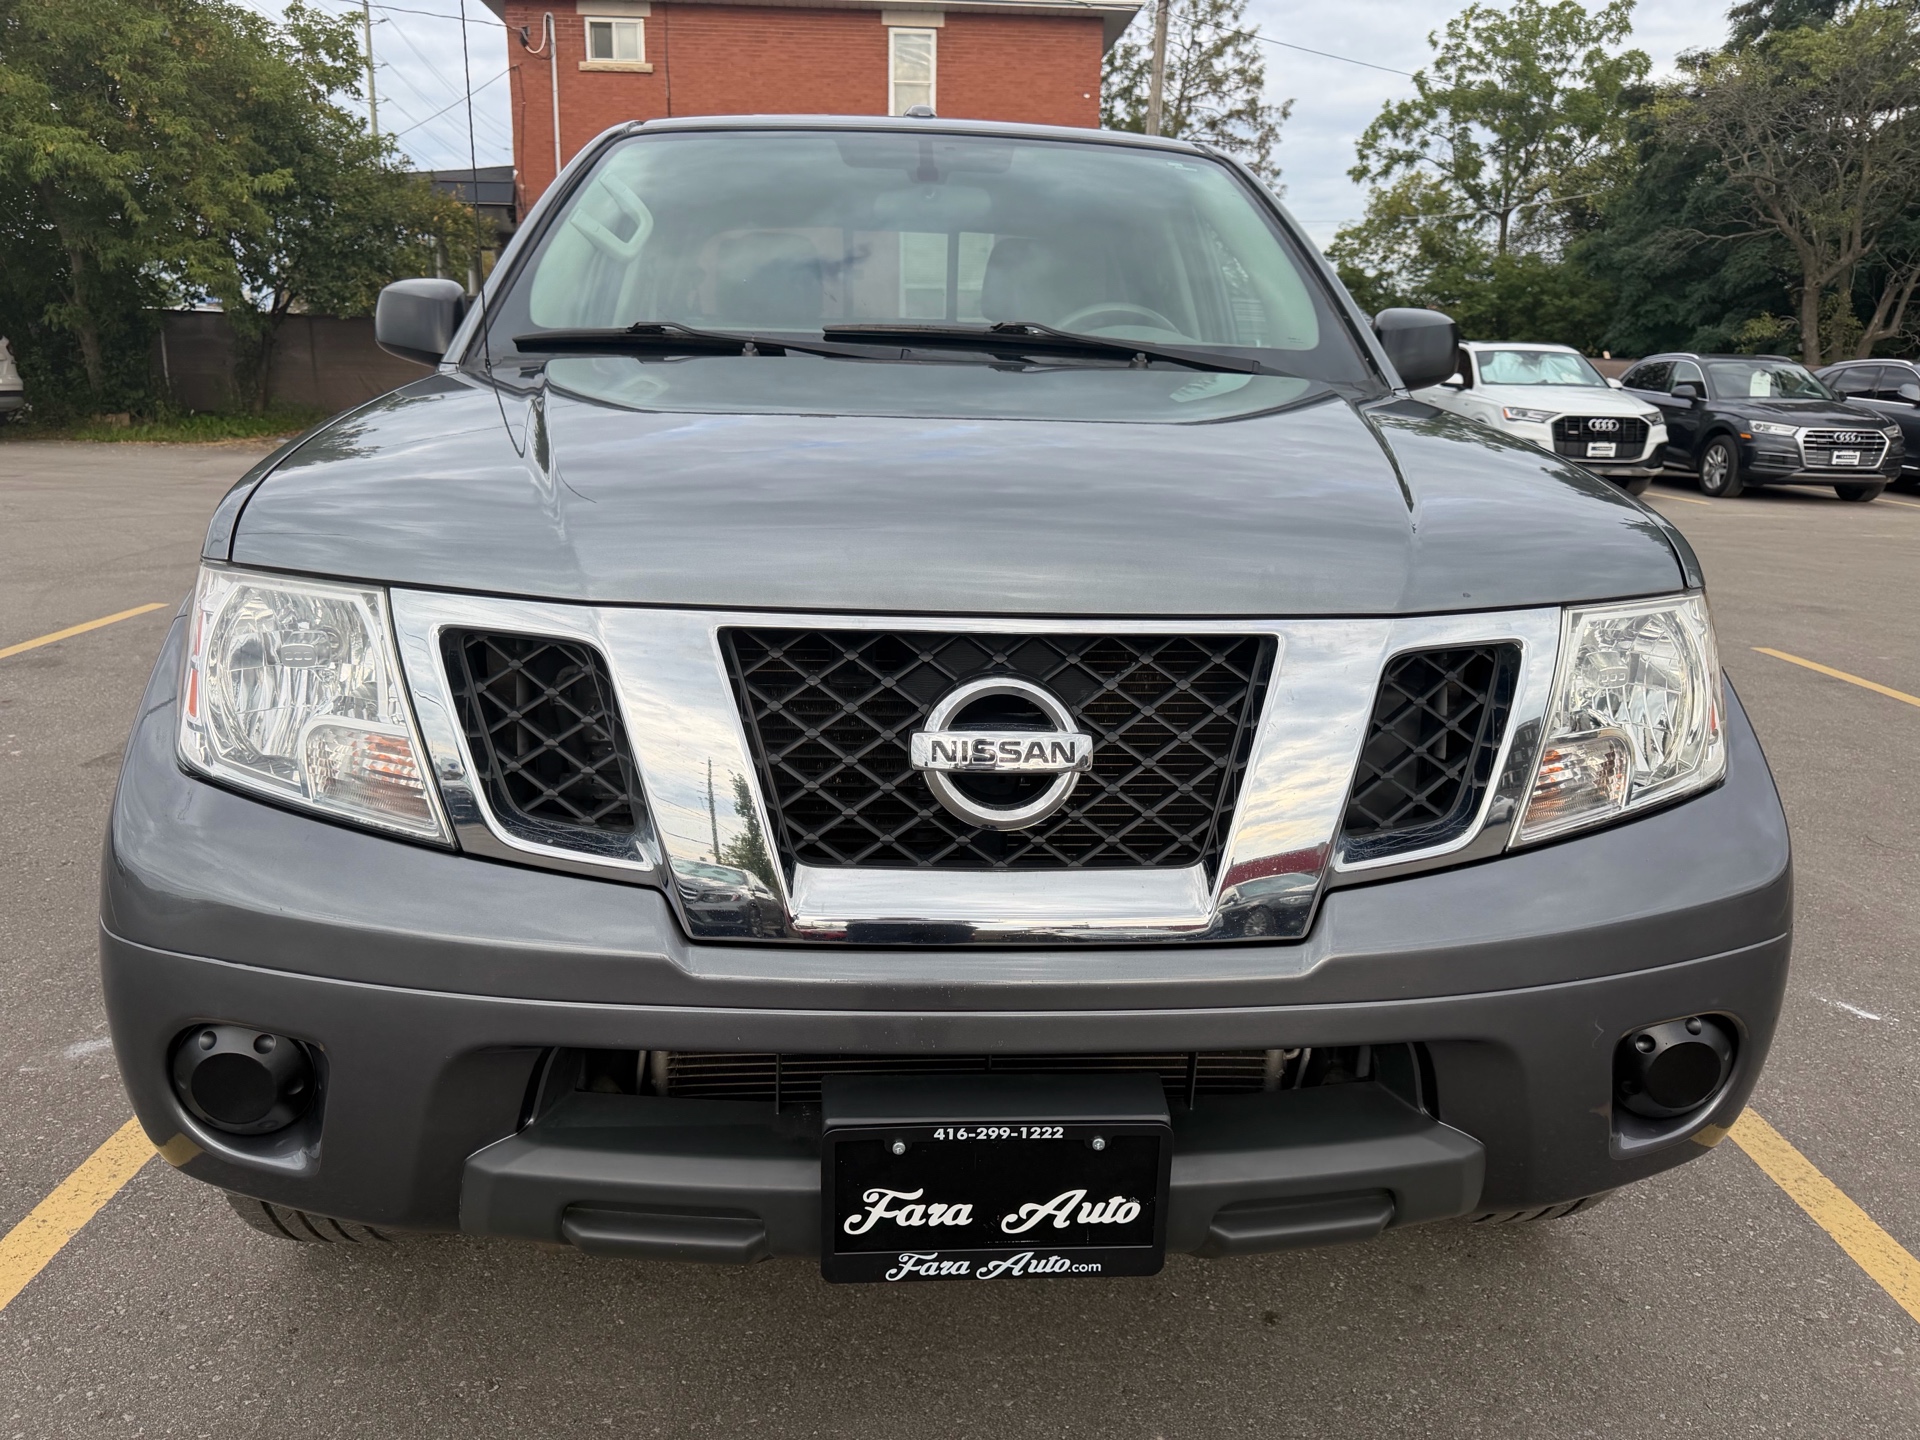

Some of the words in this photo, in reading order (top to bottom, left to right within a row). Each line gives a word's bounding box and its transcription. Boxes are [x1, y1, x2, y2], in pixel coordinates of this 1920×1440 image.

[931, 739, 1076, 764] NISSAN
[934, 1127, 1064, 1140] 416-299-1222
[844, 1188, 973, 1235] Fara
[1001, 1189, 1141, 1234] Auto
[886, 1252, 971, 1281] Fara
[976, 1252, 1102, 1280] Auto.com
